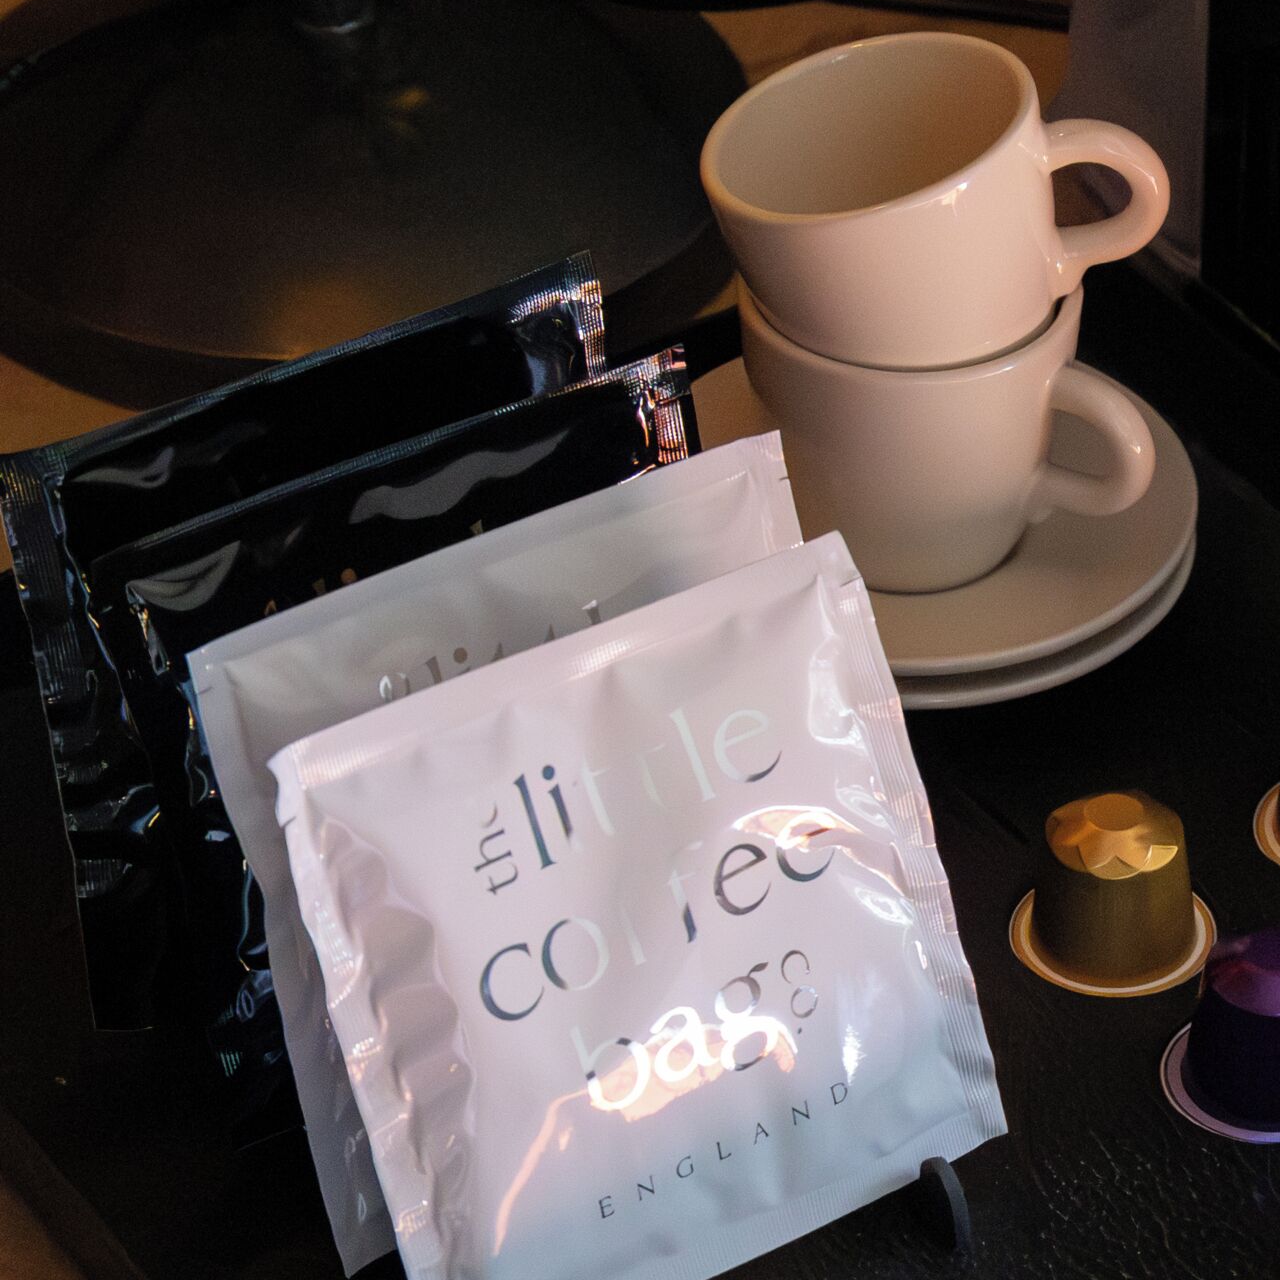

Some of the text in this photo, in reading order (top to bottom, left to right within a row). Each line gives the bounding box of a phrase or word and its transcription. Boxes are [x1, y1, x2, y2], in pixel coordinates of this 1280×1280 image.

[513, 708, 782, 870] little
[568, 961, 799, 1111] bag
[598, 1081, 850, 1219] ENGLAND
